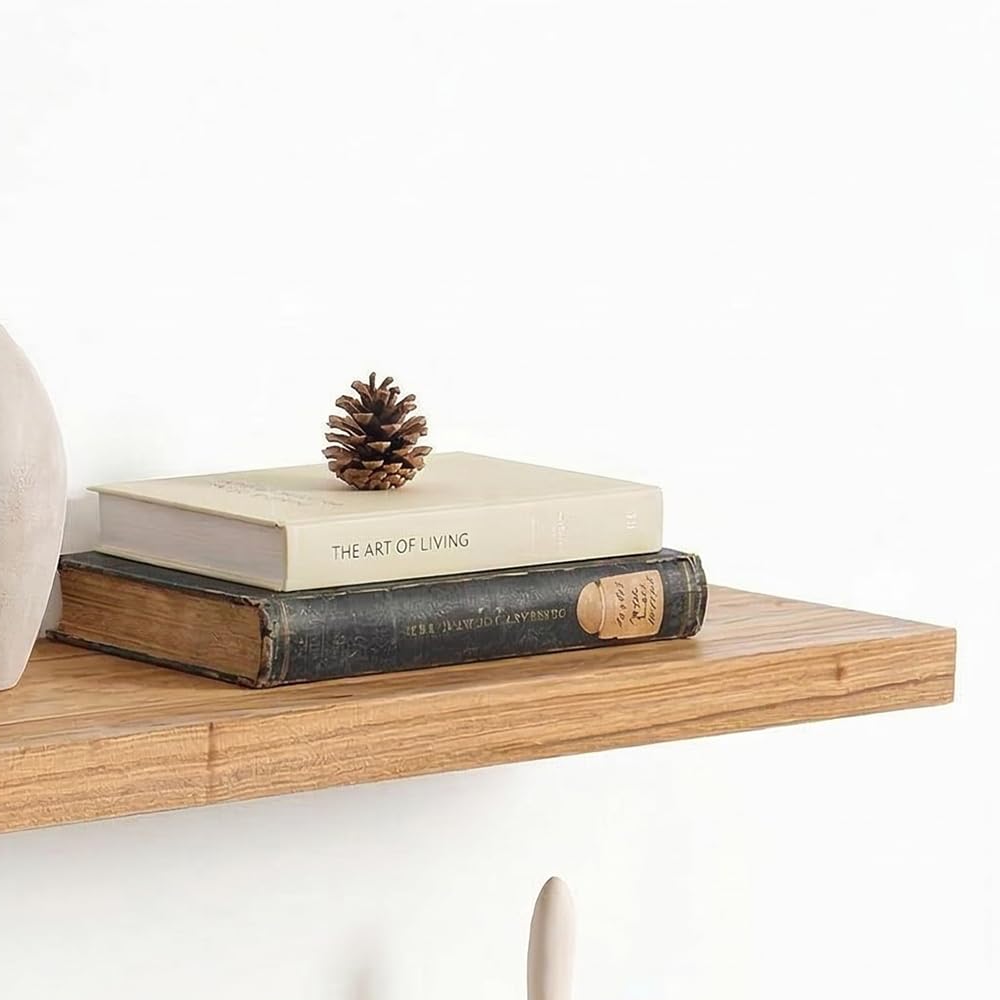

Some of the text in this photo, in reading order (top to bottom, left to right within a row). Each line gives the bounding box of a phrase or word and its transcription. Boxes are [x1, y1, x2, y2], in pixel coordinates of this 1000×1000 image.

[332, 532, 469, 560] THE ART OF LIVING
